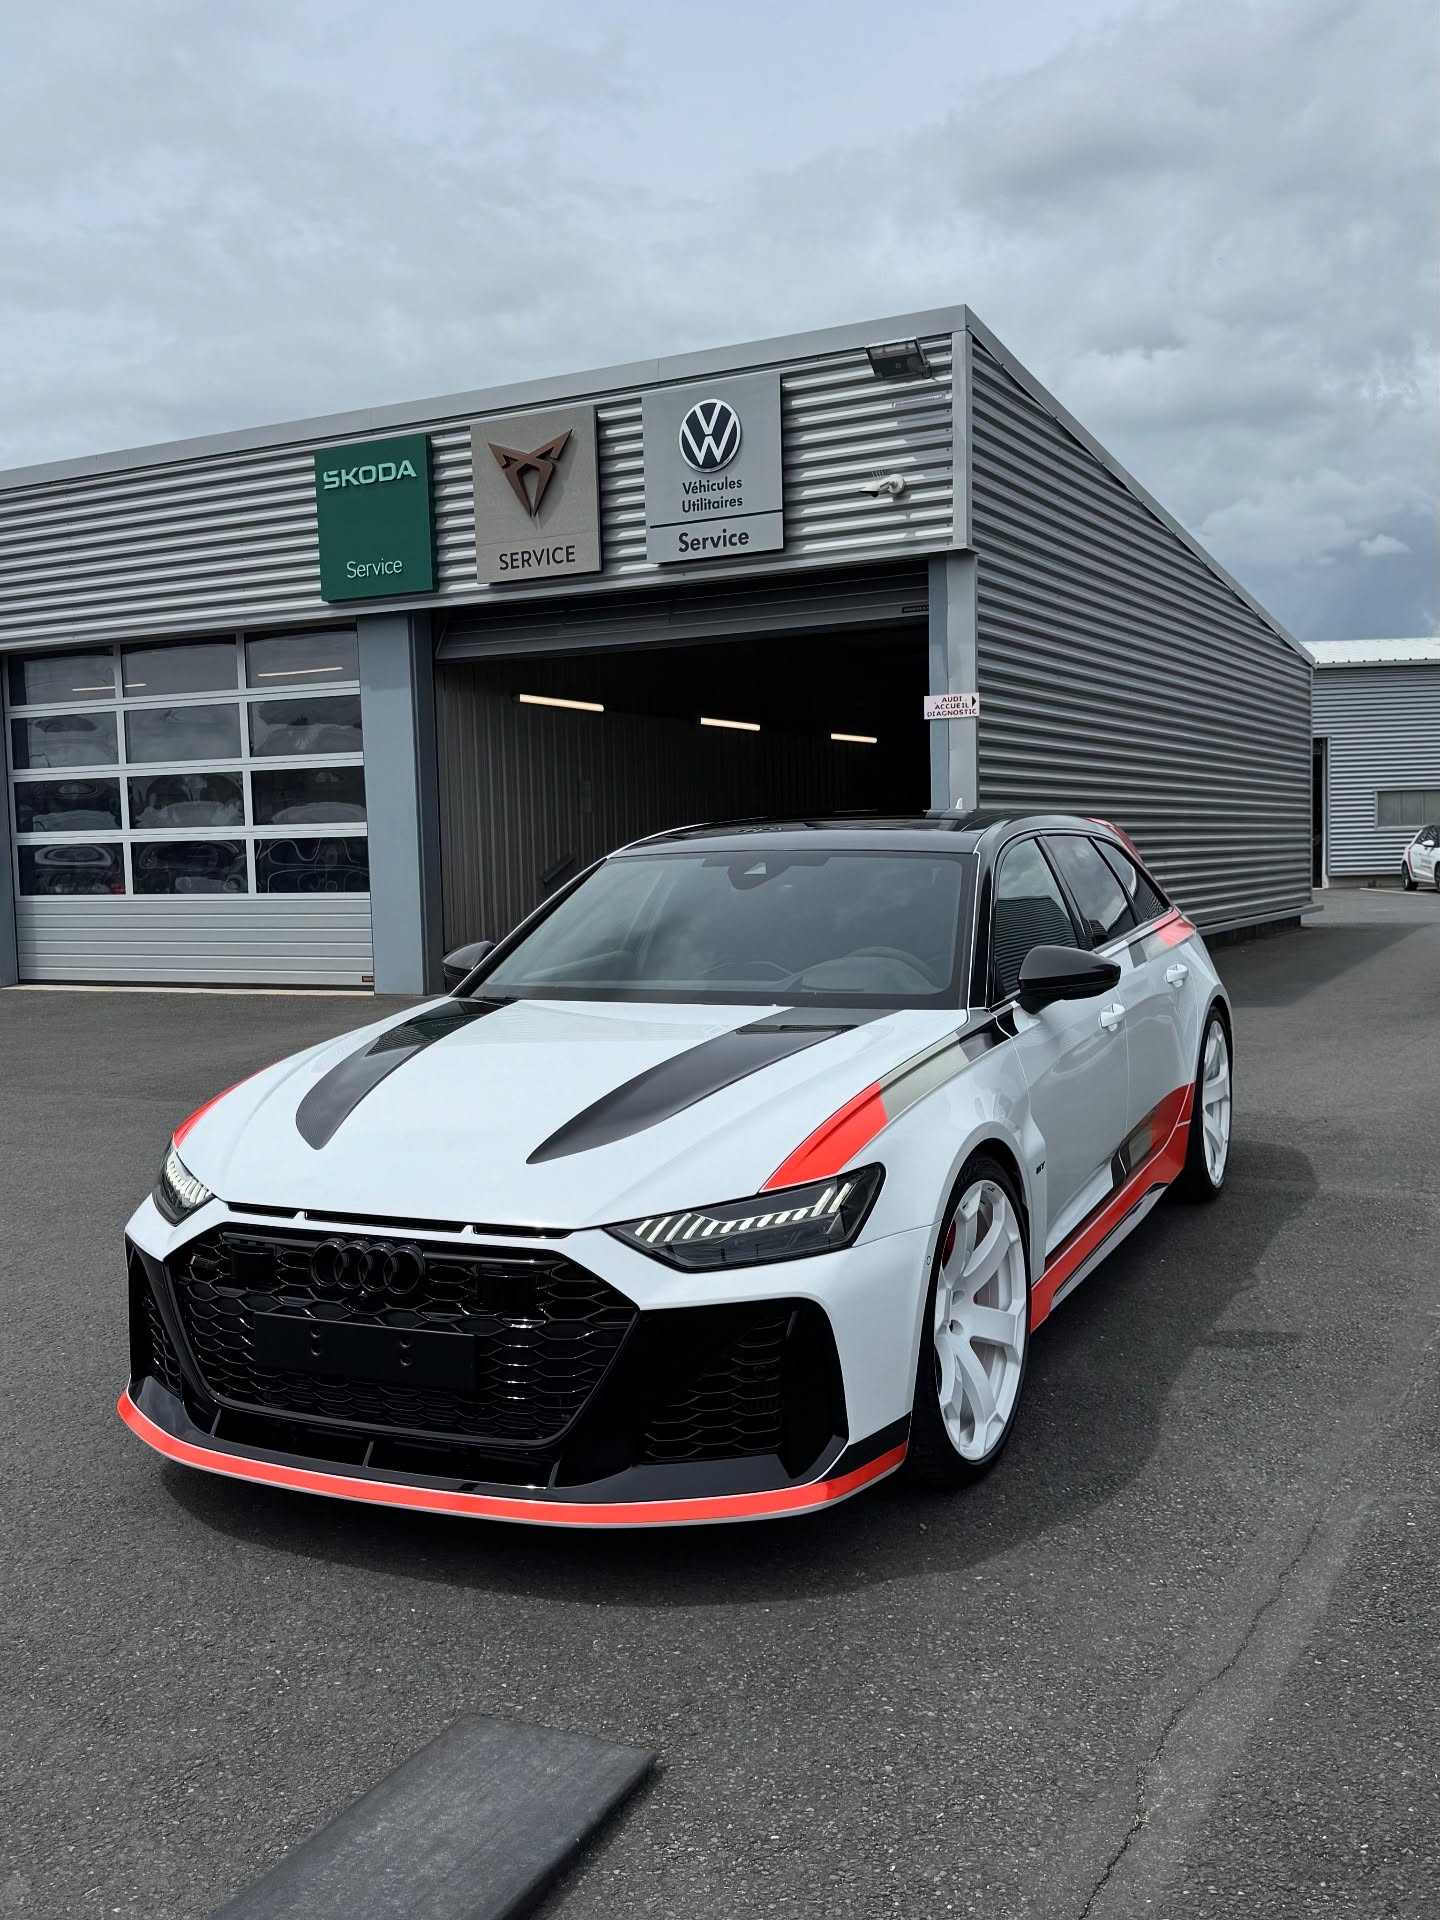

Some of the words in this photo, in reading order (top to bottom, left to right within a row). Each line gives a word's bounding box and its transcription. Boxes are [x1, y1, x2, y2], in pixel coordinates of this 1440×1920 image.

[682, 476, 742, 495] Véhicules
[682, 496, 743, 513] Utilitaires
[678, 528, 749, 552] Service
[499, 545, 576, 570] SERVICE
[346, 558, 402, 578] Service
[927, 708, 976, 717] DIAGNOSTIC
[935, 702, 969, 710] ACCUEIL
